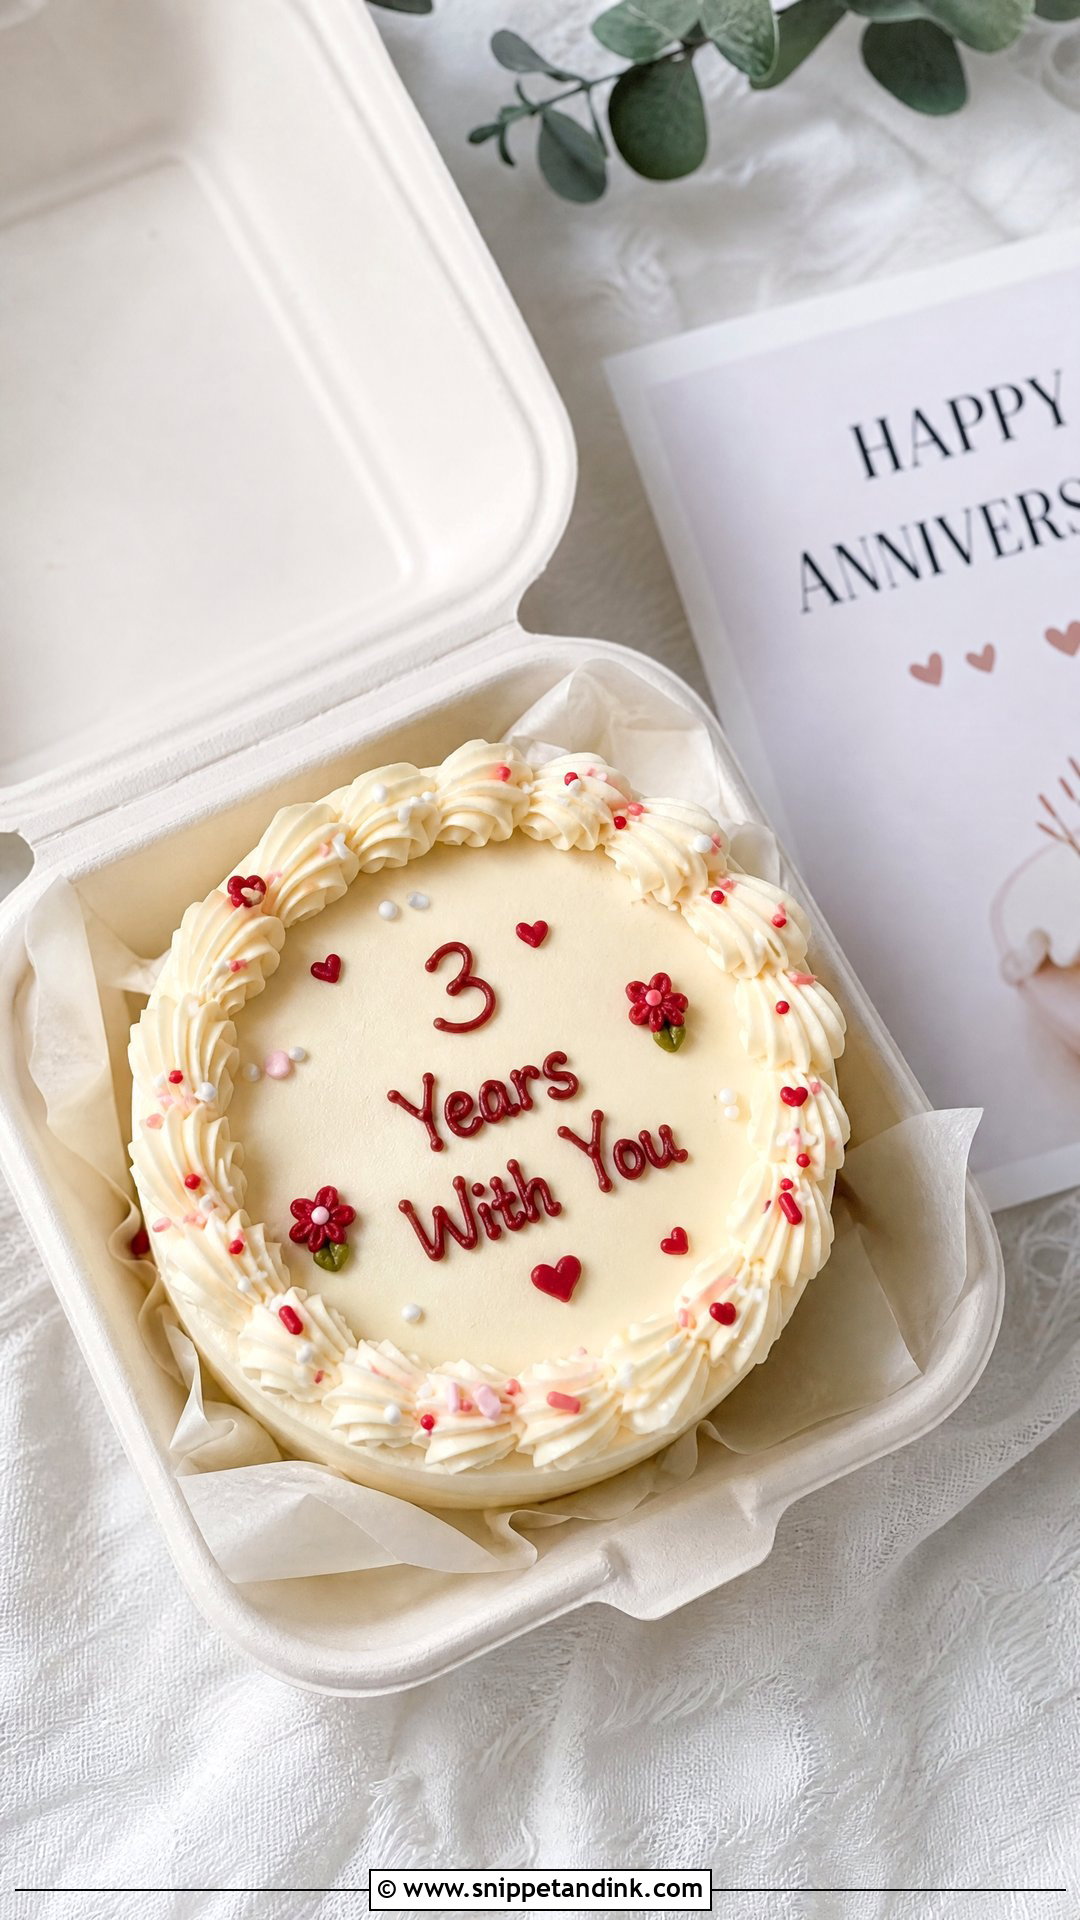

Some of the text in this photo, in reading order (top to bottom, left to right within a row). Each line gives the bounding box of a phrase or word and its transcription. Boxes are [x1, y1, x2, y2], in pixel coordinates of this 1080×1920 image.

[849, 369, 1066, 480] HAPPY
[425, 941, 496, 1033] 3
[387, 1051, 579, 1152] Years
[398, 1109, 688, 1261] With You
